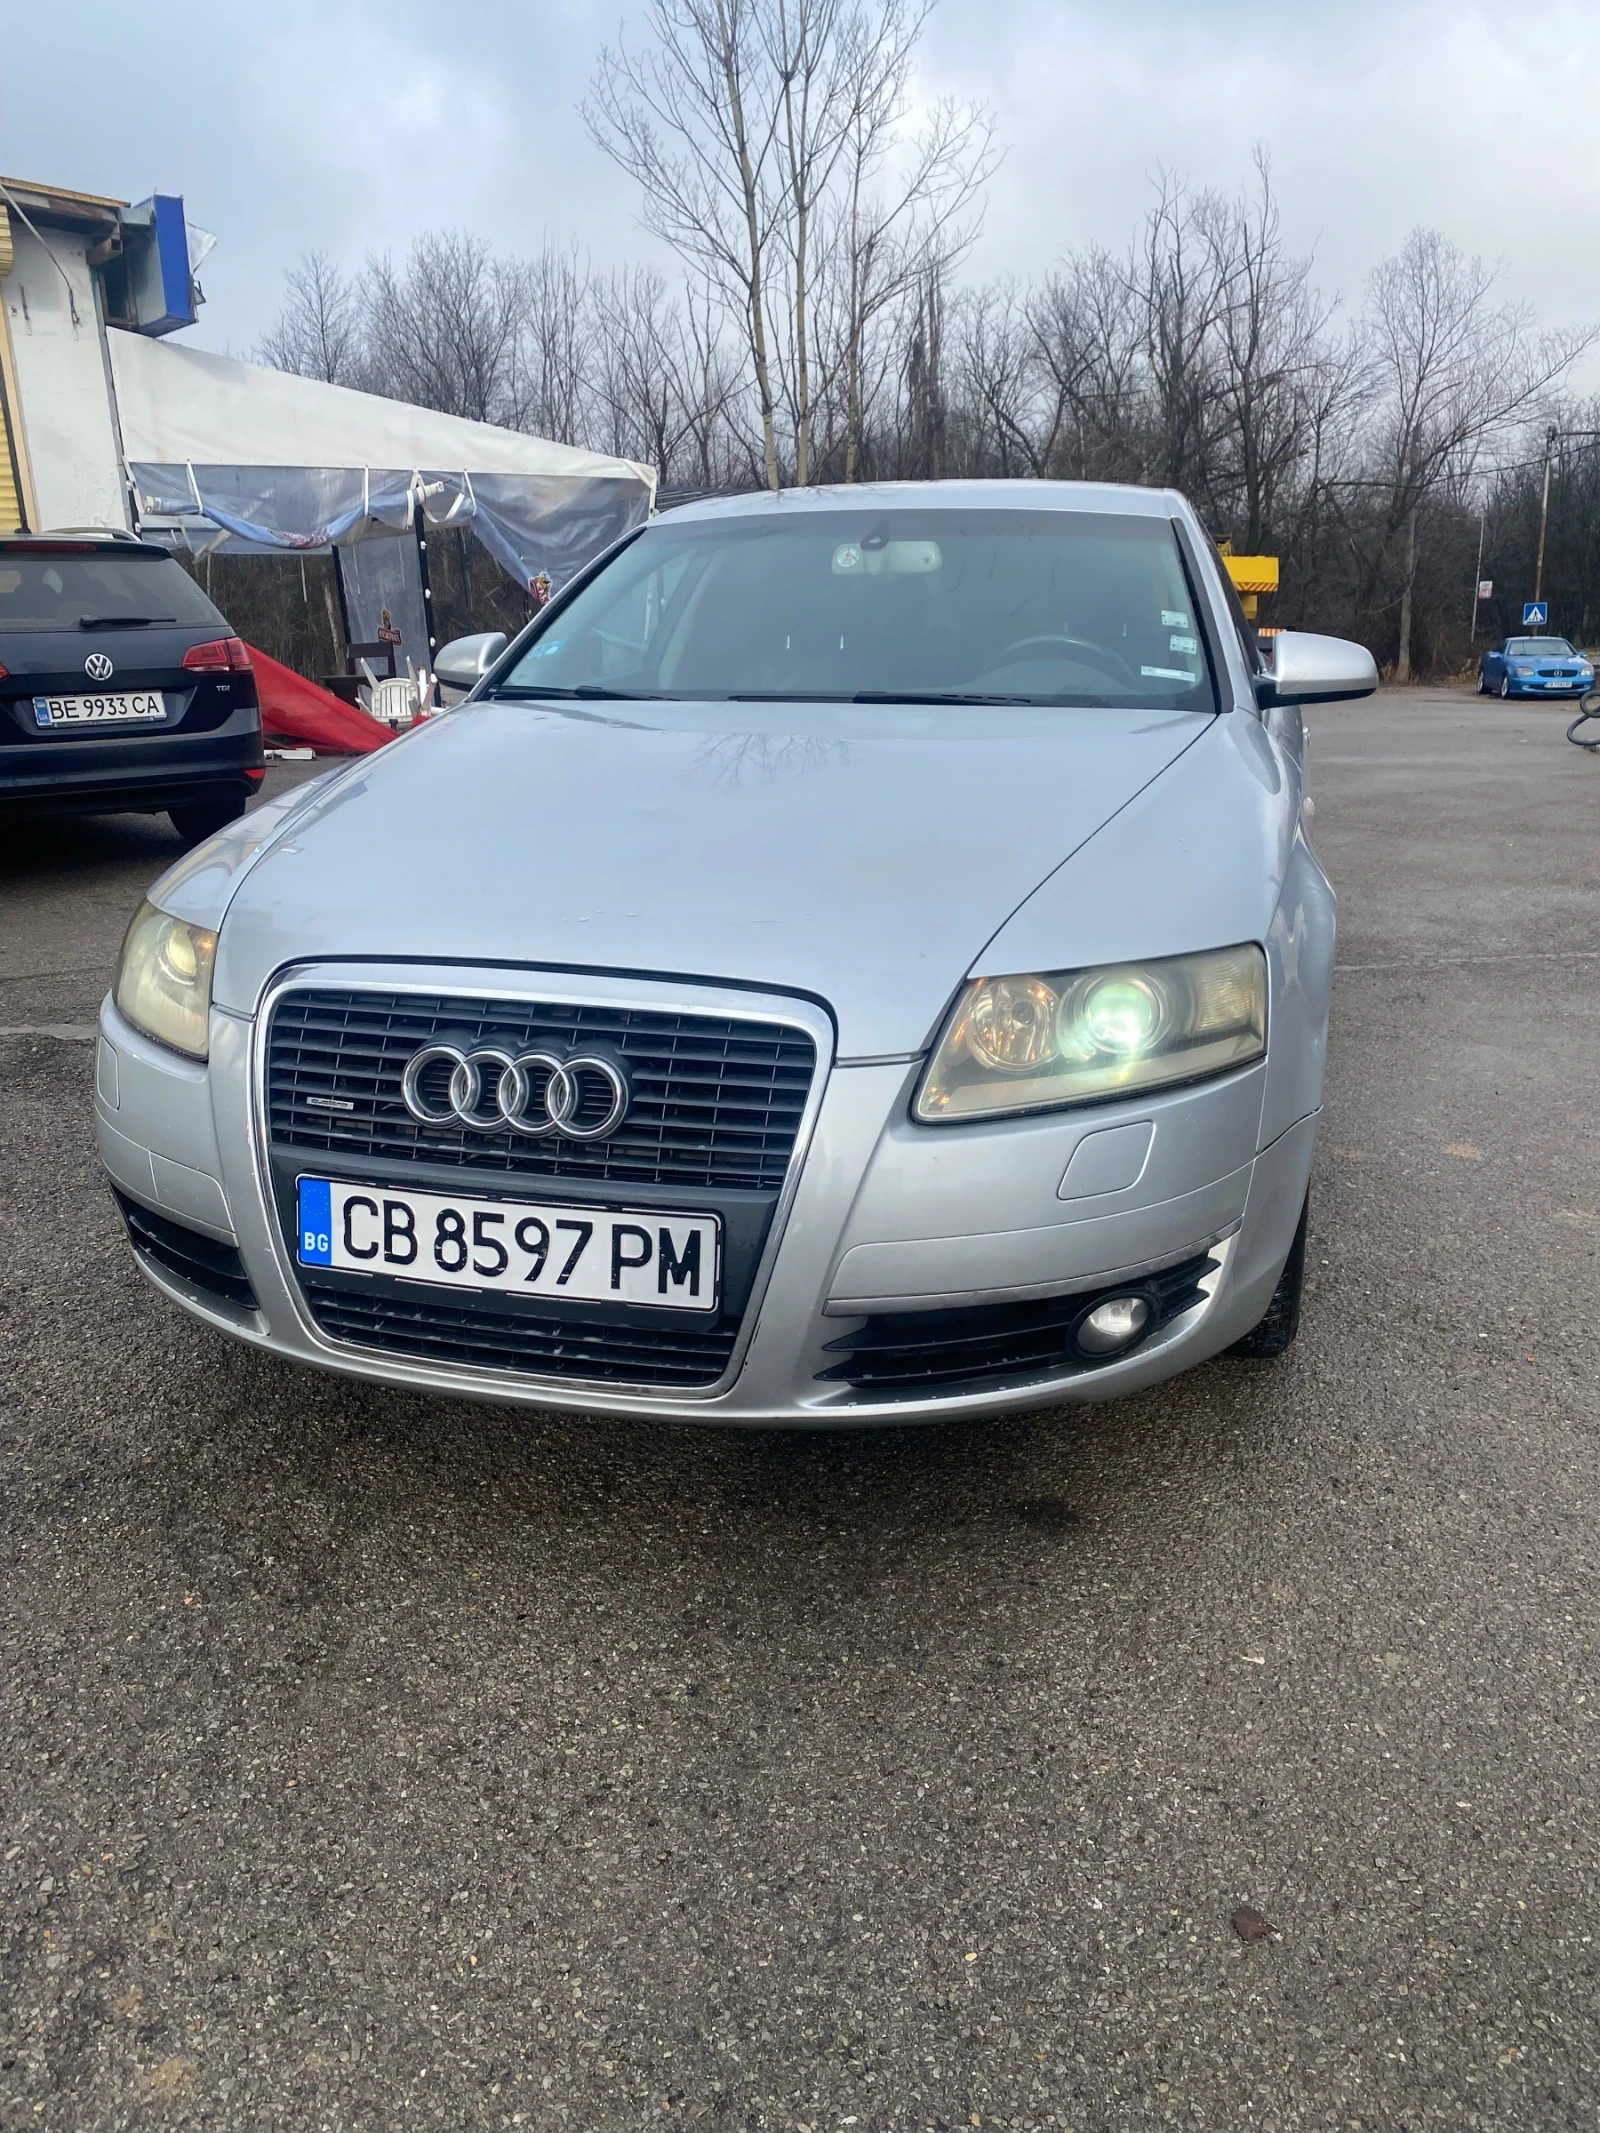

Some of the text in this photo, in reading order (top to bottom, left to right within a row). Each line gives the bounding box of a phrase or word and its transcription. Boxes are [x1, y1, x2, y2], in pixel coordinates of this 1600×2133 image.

[215, 684, 230, 692] TDI
[49, 695, 160, 719] BE 9933 CA
[304, 1231, 329, 1252] BG
[342, 1194, 702, 1296] CB 8597 PM
